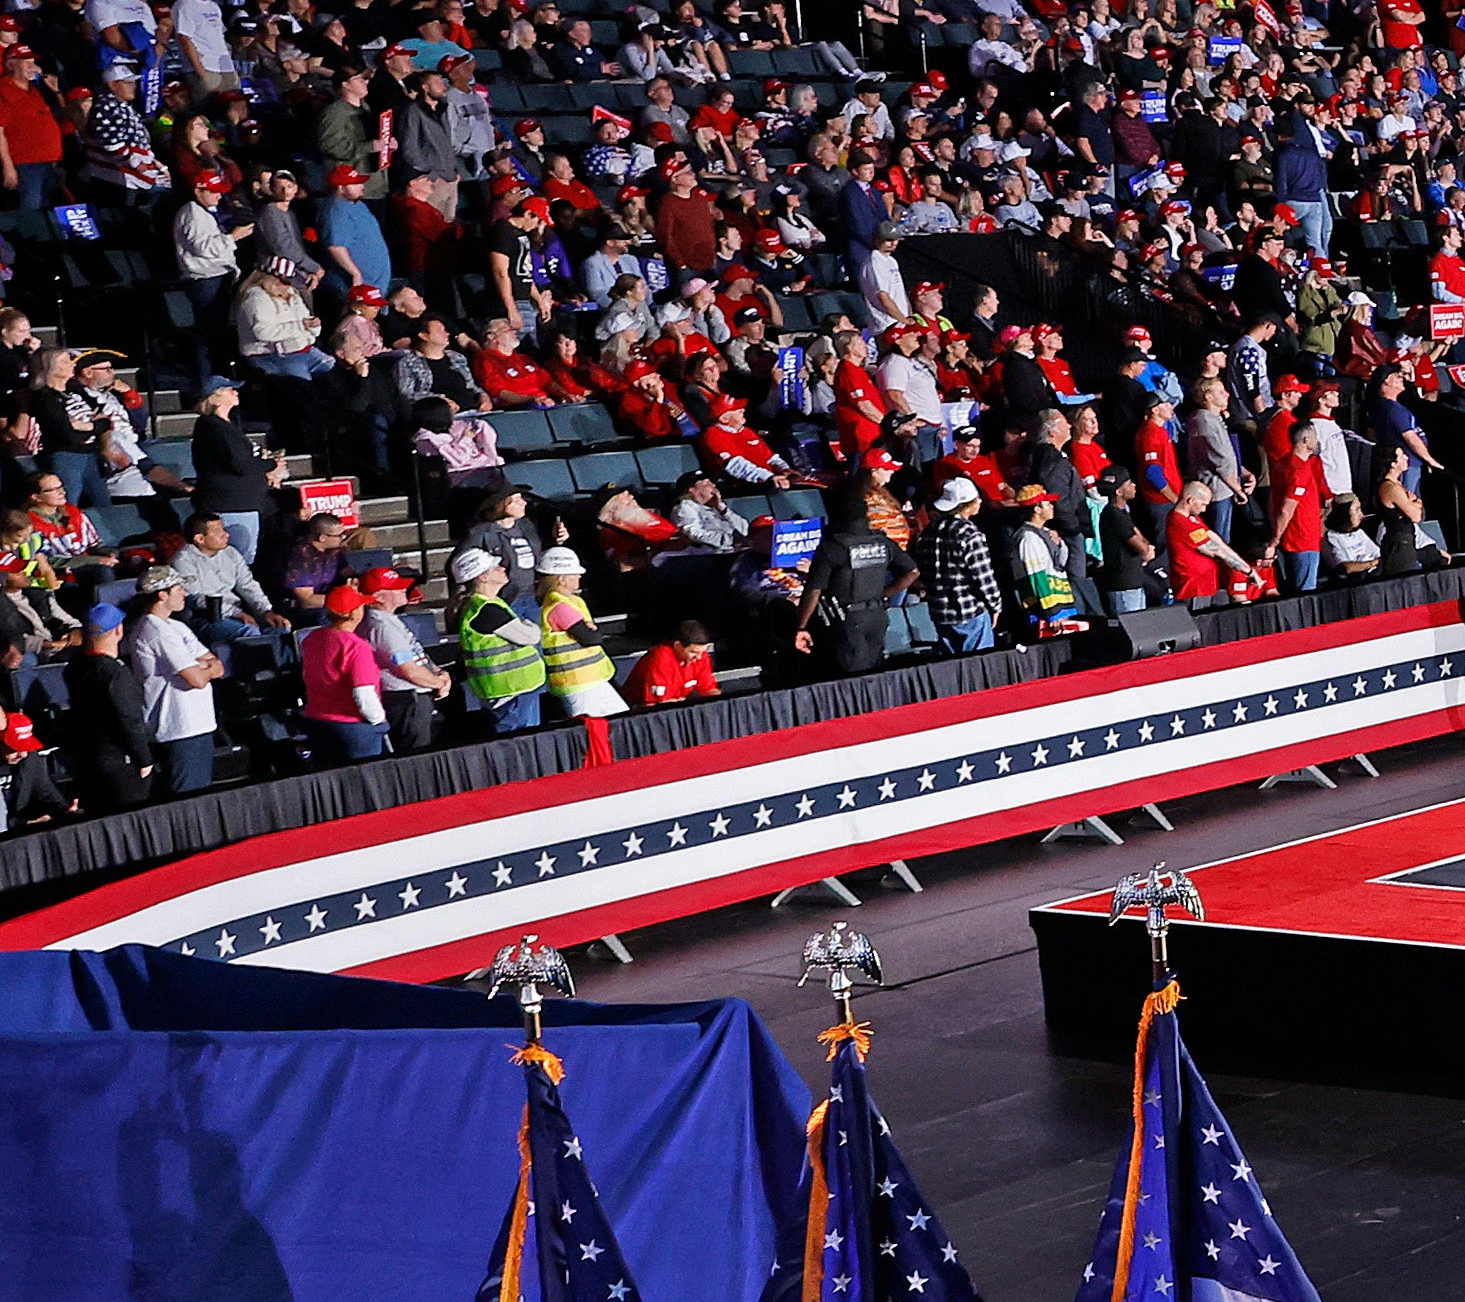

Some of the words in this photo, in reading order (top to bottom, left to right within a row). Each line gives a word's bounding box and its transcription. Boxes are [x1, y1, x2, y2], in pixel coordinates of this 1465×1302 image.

[1434, 318, 1463, 331] AGAIN!
[308, 494, 352, 513] TRUMP
[776, 530, 808, 543] DREAM
[776, 538, 820, 556] AGAIN!
[851, 545, 887, 559] POLICE
